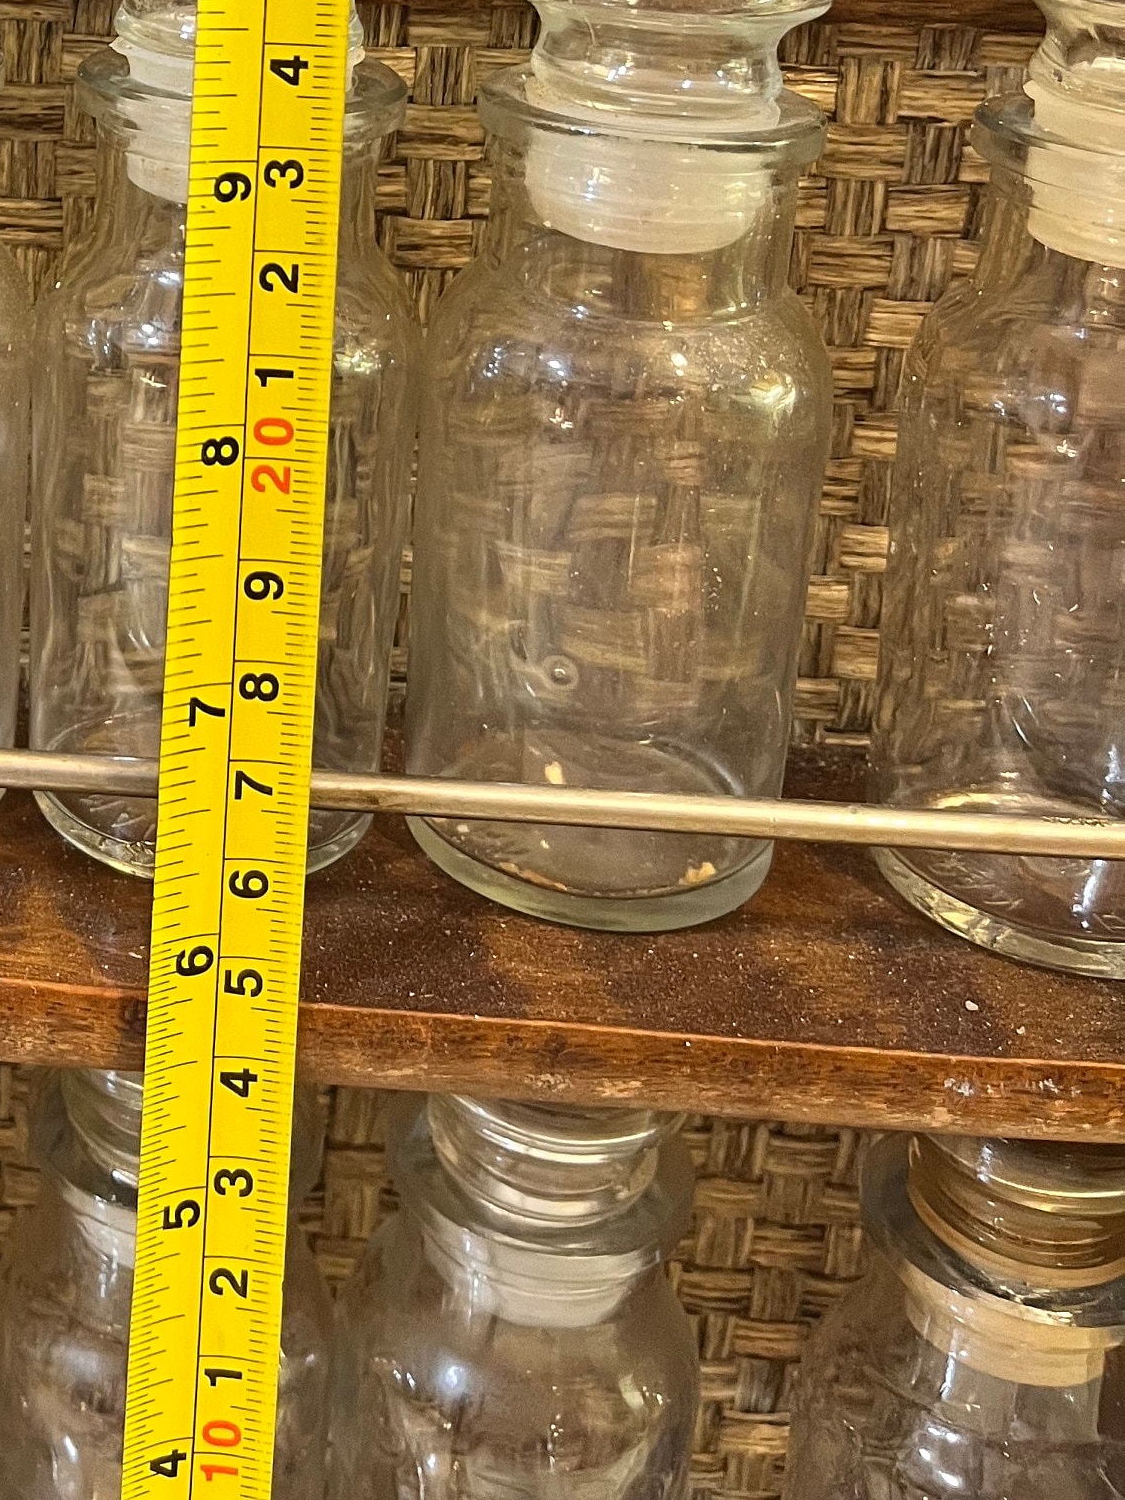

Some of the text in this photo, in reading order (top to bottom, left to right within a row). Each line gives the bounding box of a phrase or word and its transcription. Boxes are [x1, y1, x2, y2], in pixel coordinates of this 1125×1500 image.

[269, 55, 309, 86] 4
[213, 172, 252, 203] 9
[263, 159, 304, 189] 3
[259, 263, 299, 294] 2
[254, 368, 294, 388] 1
[200, 436, 240, 466] 8
[250, 416, 295, 496] 20
[243, 571, 284, 601] 9
[238, 673, 280, 702] 8
[188, 697, 226, 727] 7
[234, 770, 273, 800] 7
[228, 870, 269, 899] 6
[175, 945, 214, 977] 6
[223, 969, 263, 998] 5
[219, 1068, 258, 1098] 4
[213, 1169, 254, 1198] 3
[162, 1199, 201, 1230] 5
[209, 1268, 248, 1299] 2
[204, 1369, 243, 1387] 1
[149, 1449, 187, 1478] 4
[199, 1419, 242, 1484] 10
